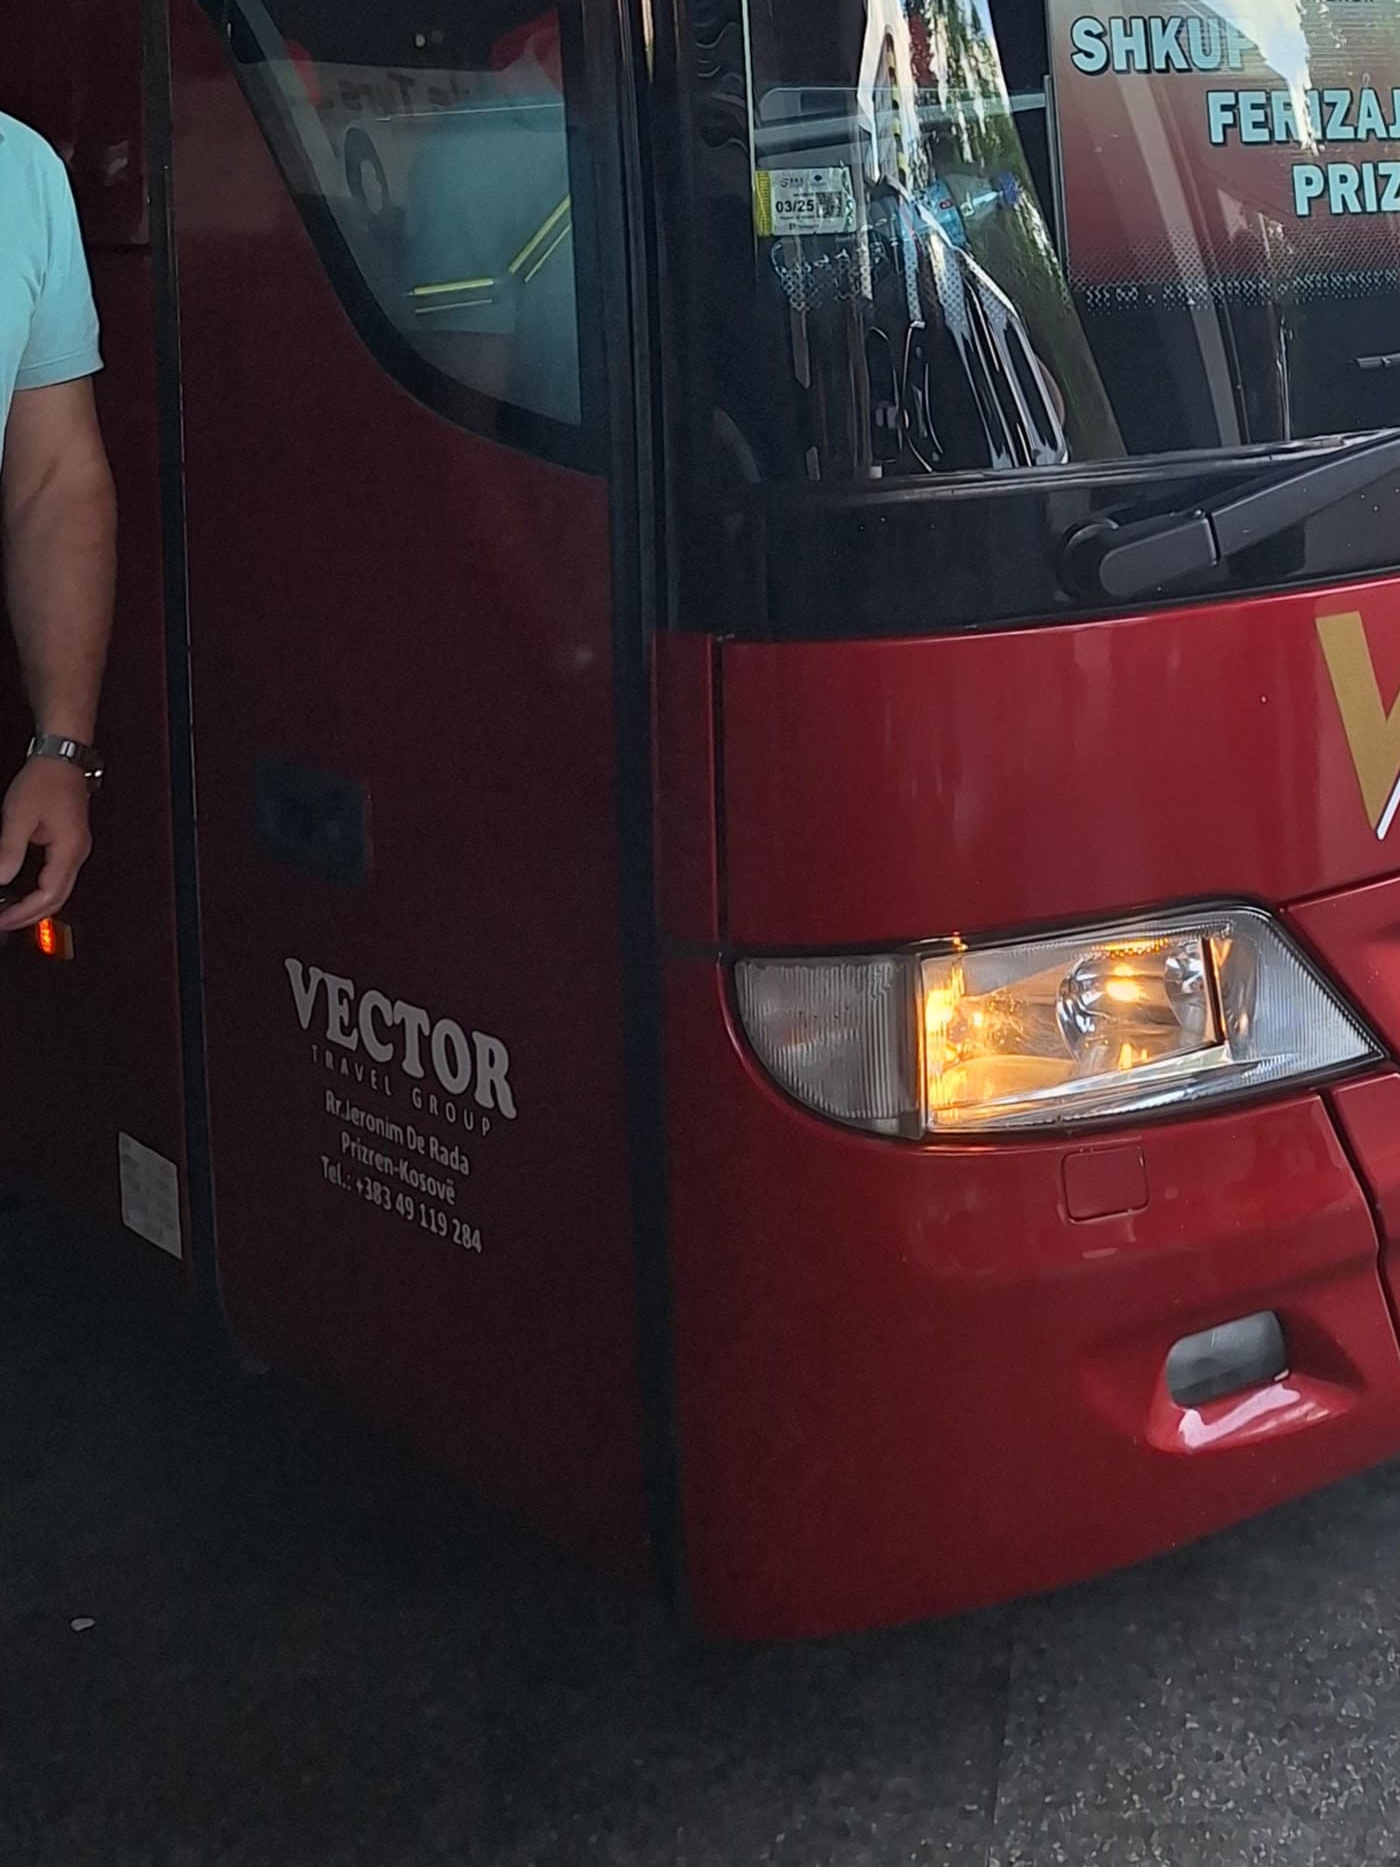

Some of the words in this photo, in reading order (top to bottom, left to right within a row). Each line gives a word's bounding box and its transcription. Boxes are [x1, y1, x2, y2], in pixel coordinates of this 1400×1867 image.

[775, 199, 815, 214] 03/25
[284, 957, 517, 1120] VECTOR
[311, 1044, 393, 1097] TRAVEL
[412, 1086, 490, 1138] GROUP
[406, 1124, 426, 1155] De
[429, 1136, 470, 1176] Rada
[356, 1176, 392, 1211] +383
[395, 1193, 415, 1221] 49
[419, 1203, 448, 1238] 119
[451, 1217, 483, 1254] 284
